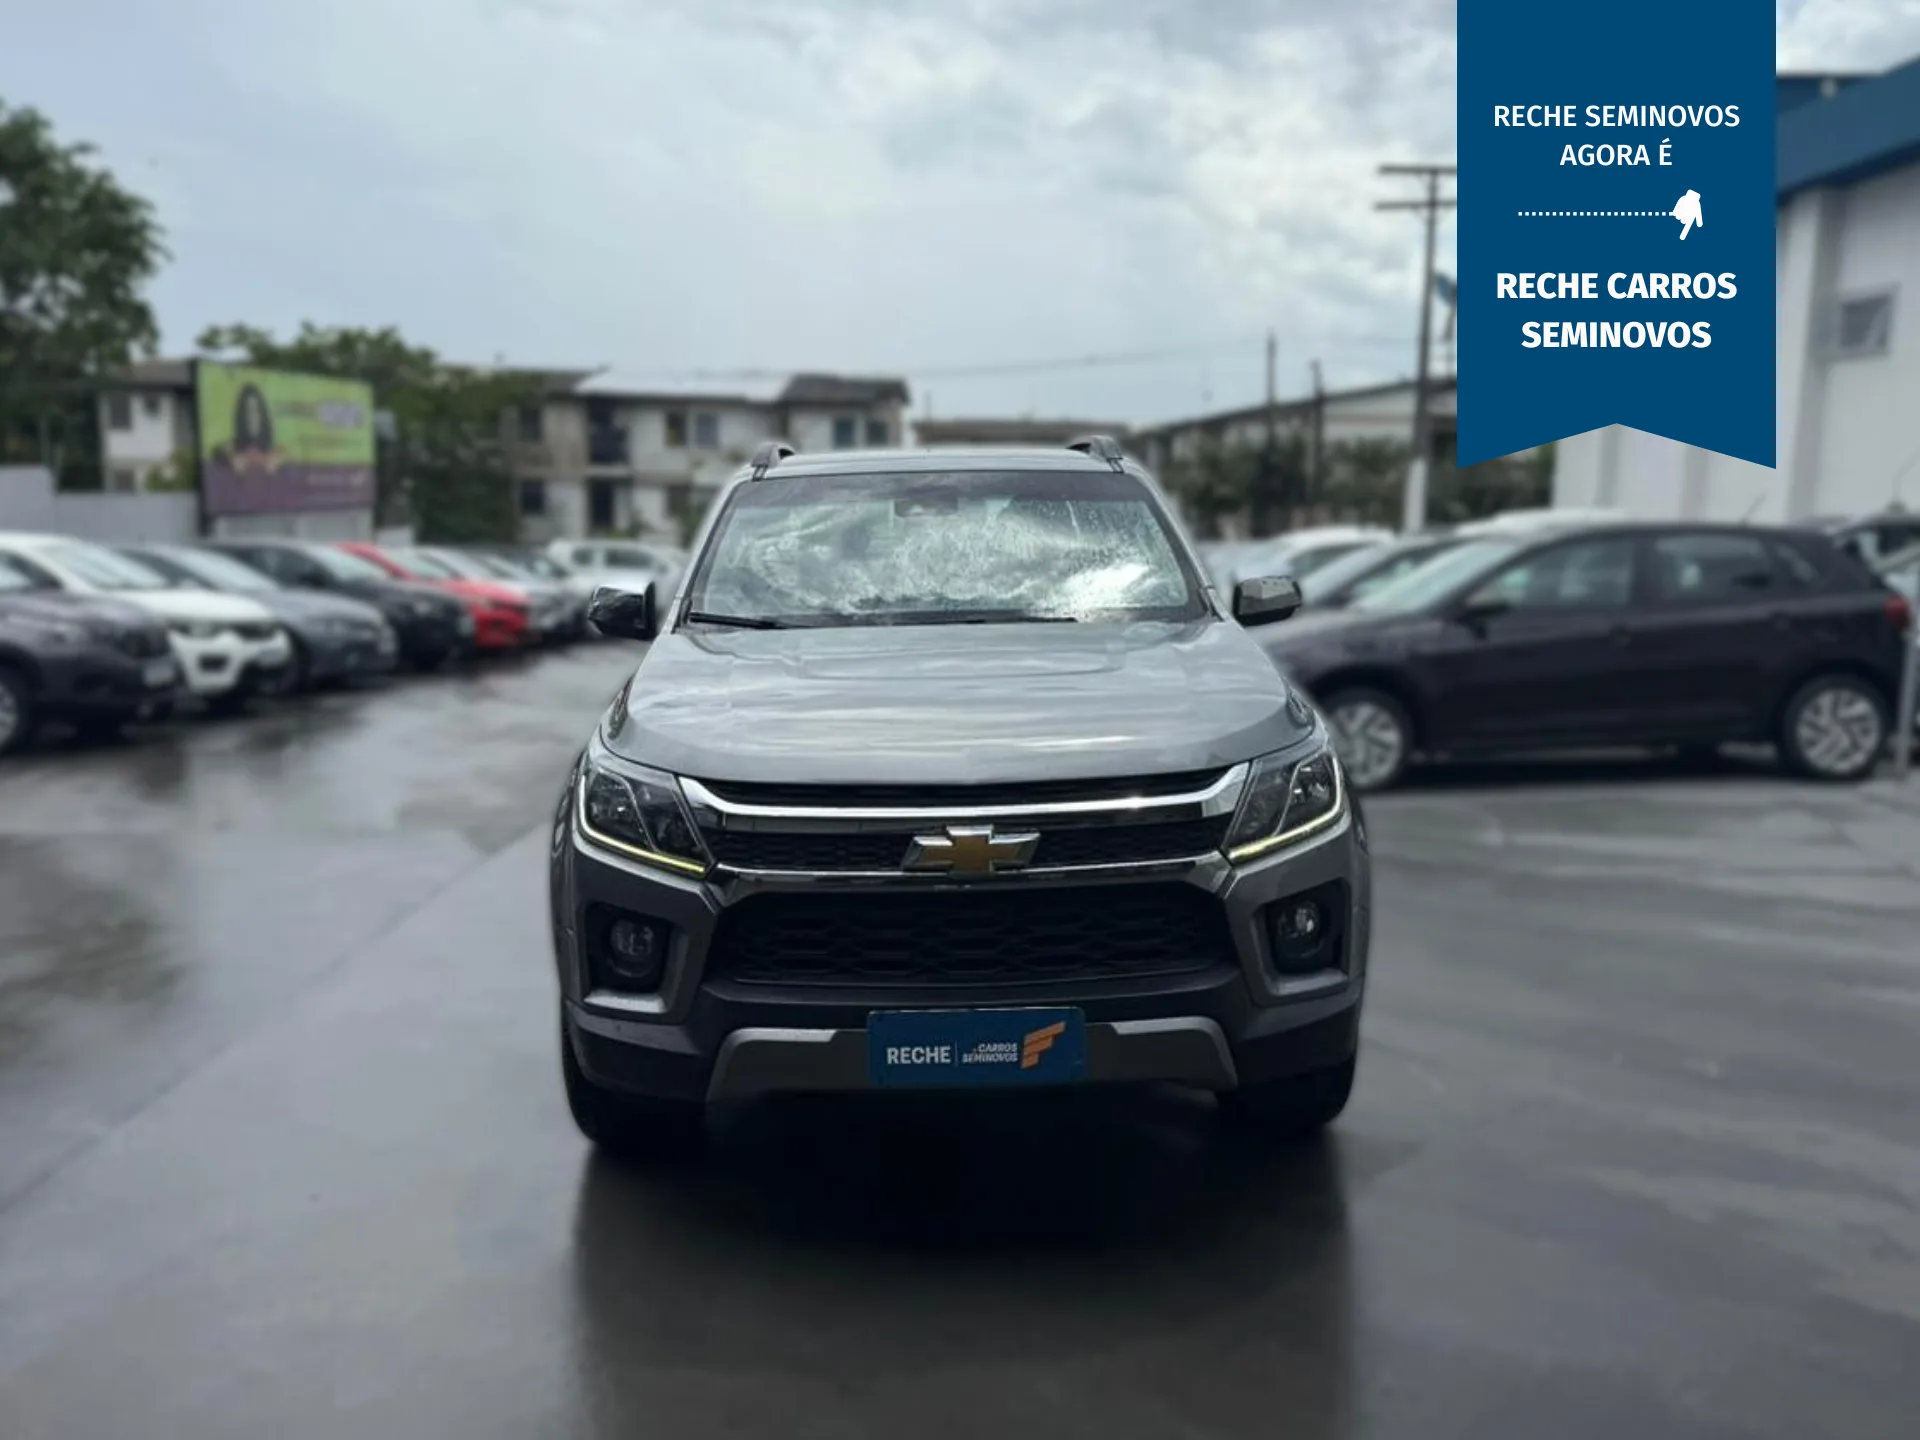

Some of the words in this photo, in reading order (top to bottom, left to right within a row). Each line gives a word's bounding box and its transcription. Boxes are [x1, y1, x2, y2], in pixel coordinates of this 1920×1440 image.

[977, 1042, 1018, 1053] CARROS
[886, 1045, 951, 1065] RECHE
[962, 1052, 1019, 1063] SEMINOVOS
